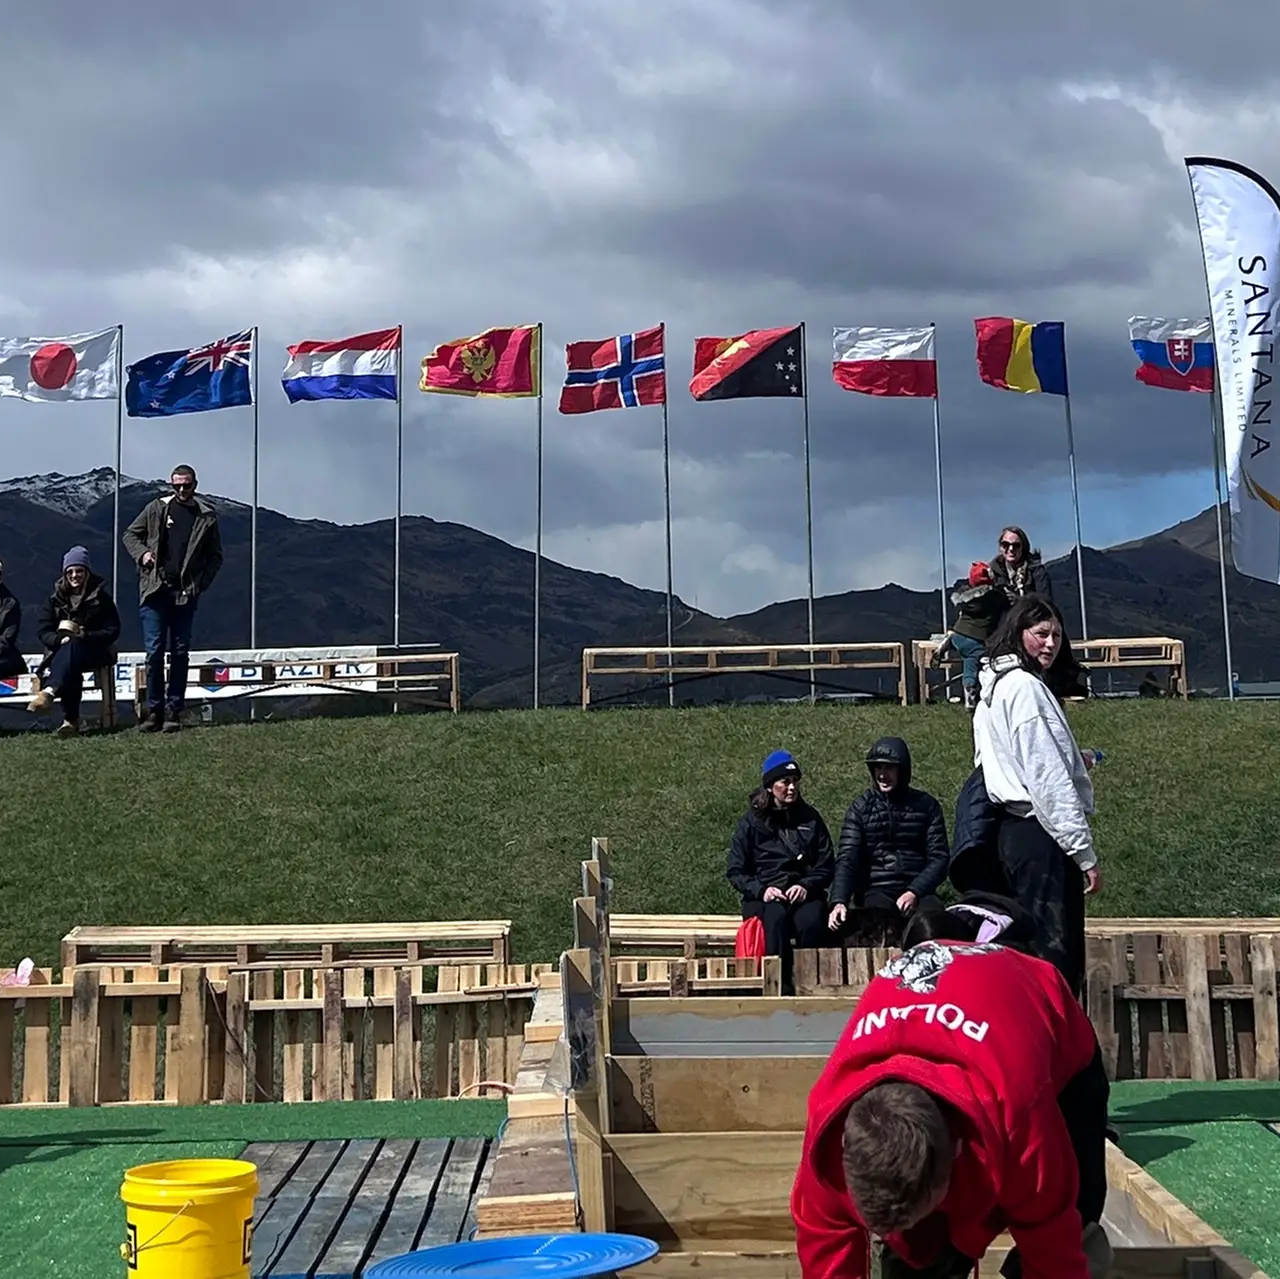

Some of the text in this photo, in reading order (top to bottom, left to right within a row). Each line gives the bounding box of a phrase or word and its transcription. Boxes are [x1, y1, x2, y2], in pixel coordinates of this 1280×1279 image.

[1224, 290, 1247, 432] MINERALS LIMITED
[1238, 256, 1273, 459] SANTANA
